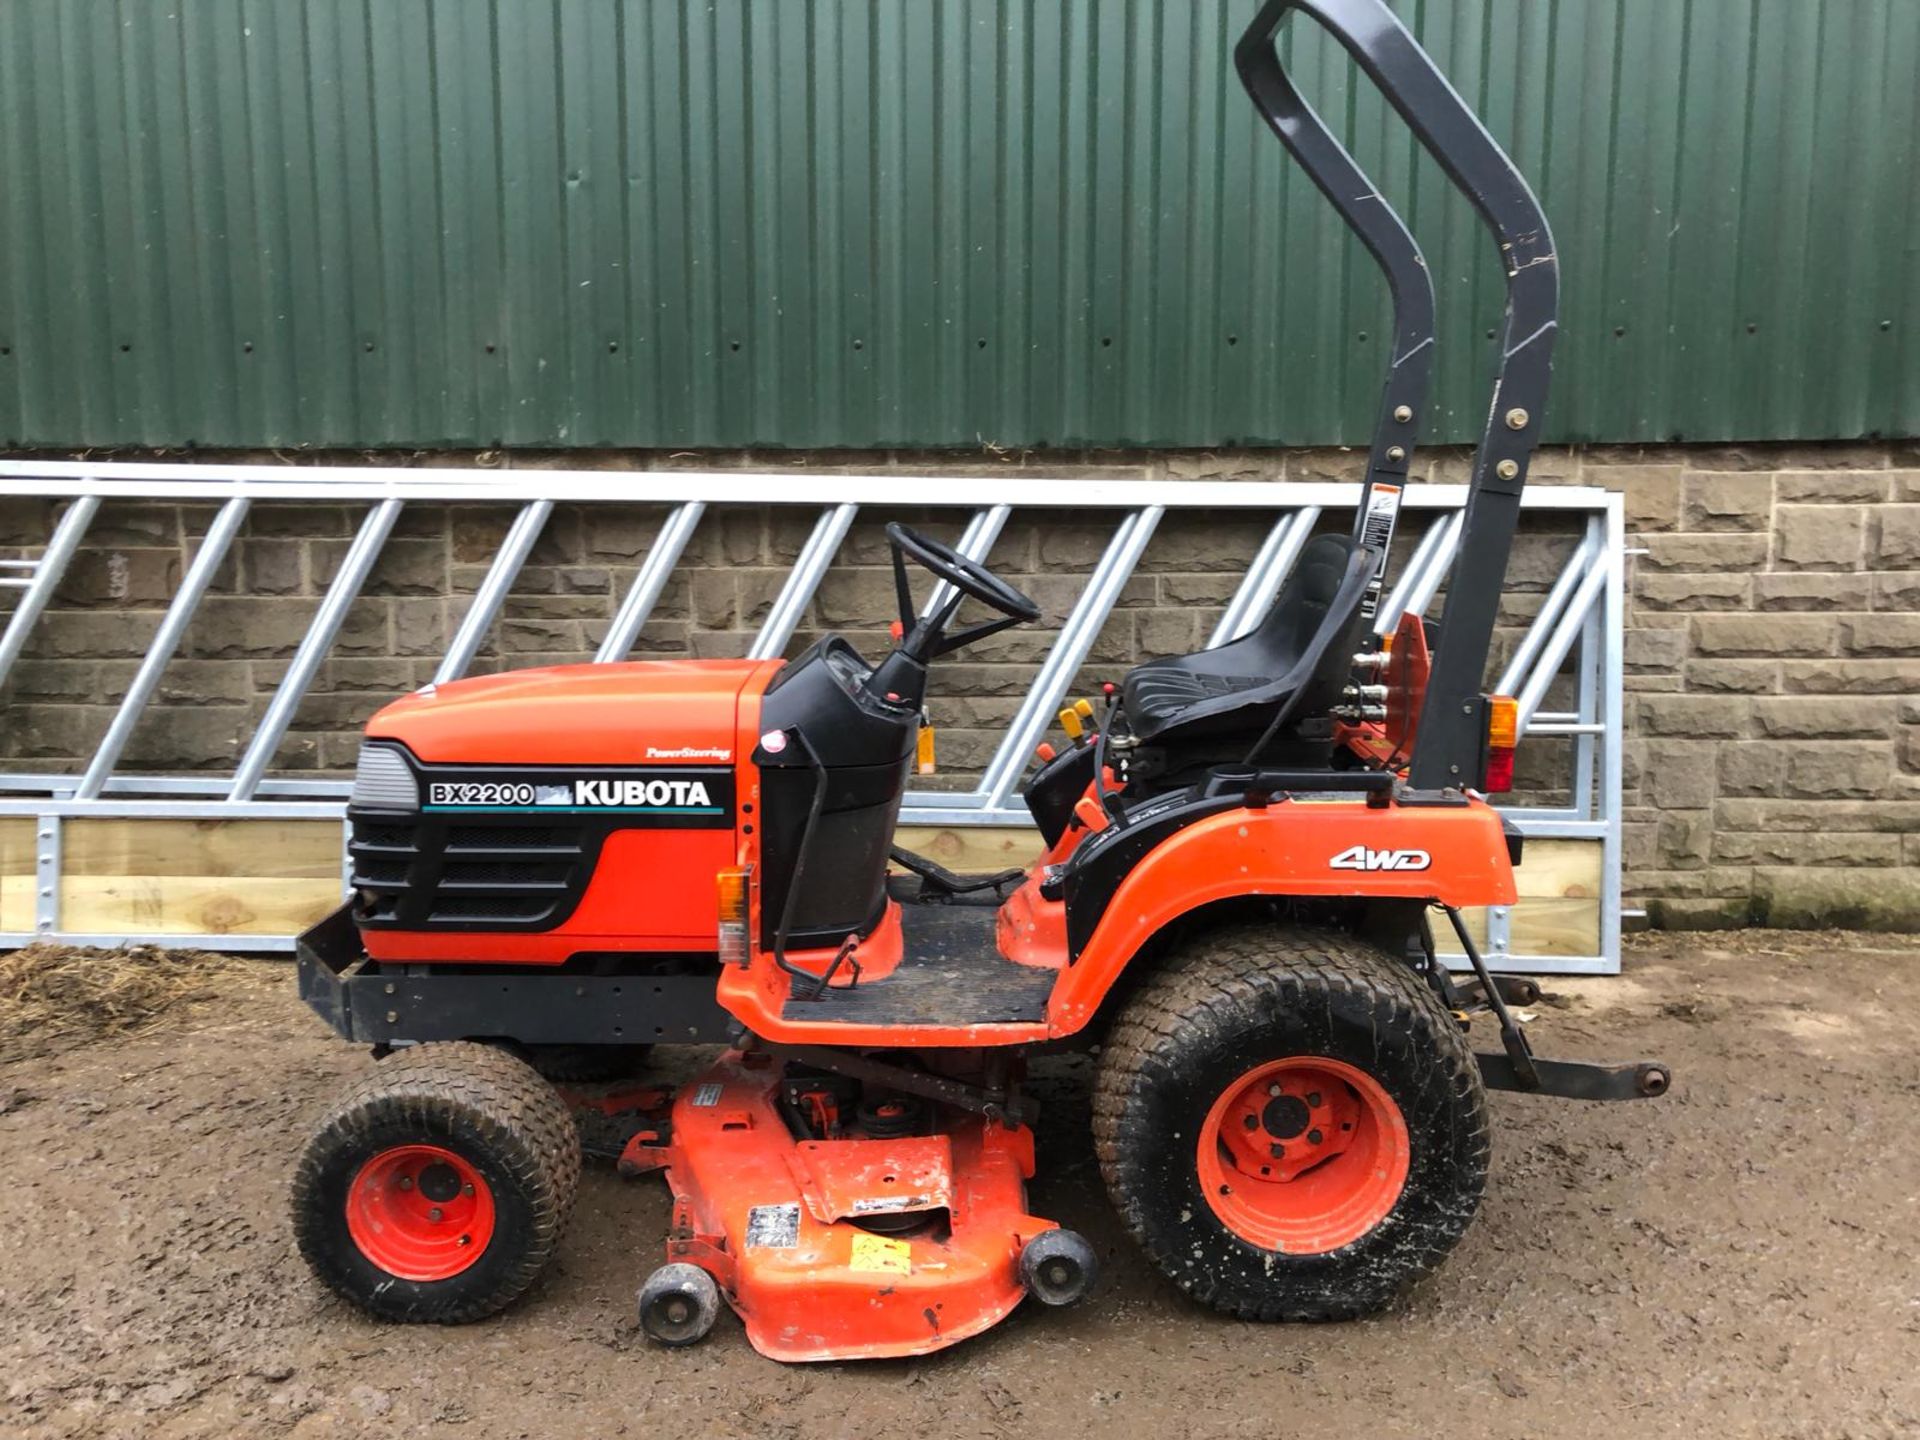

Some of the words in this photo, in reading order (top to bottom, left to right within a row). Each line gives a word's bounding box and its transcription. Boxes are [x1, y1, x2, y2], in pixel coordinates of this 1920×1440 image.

[430, 783, 535, 805] BX2200
[576, 780, 711, 806] KUBOTA
[1329, 845, 1431, 871] 4WD
